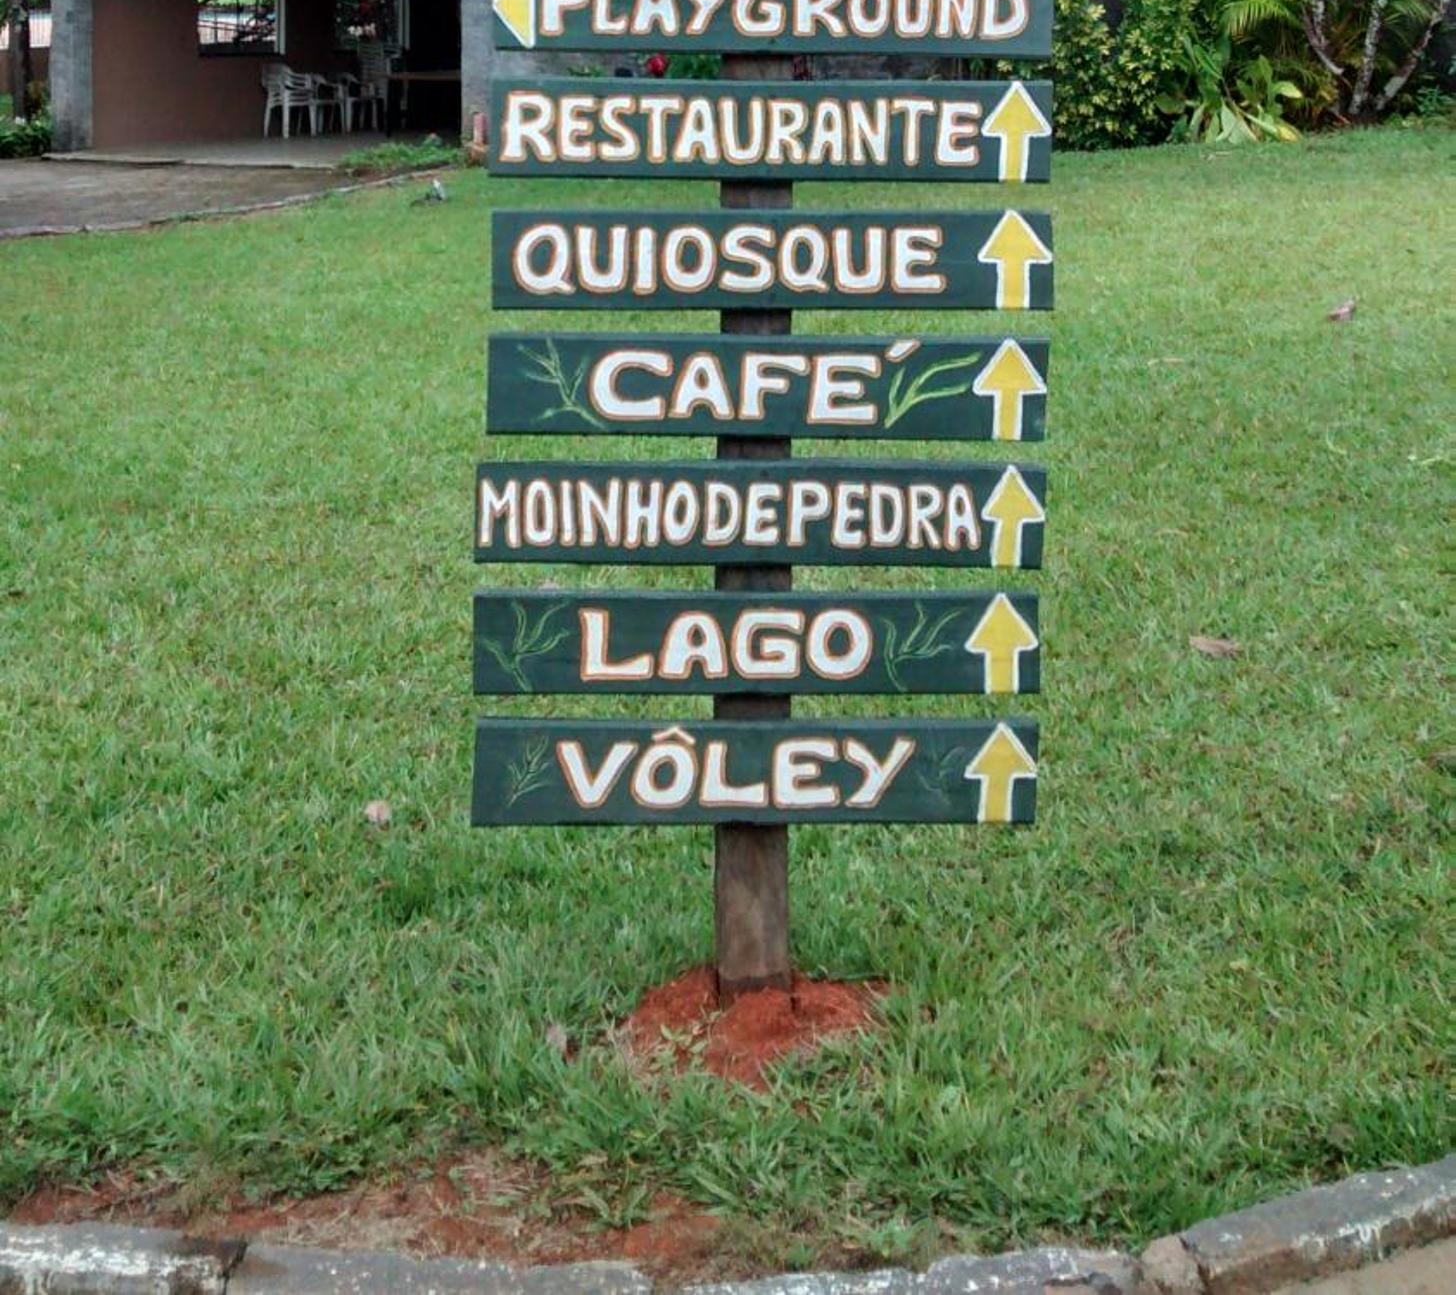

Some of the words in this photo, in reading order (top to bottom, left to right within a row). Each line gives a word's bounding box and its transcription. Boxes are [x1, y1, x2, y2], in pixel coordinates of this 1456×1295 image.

[499, 89, 983, 167] RESTAURANTE
[512, 224, 948, 295] QUIOSQUE
[588, 339, 921, 426] CAFÉ
[578, 607, 873, 682] LAGO
[556, 726, 916, 809] VÔLEY
